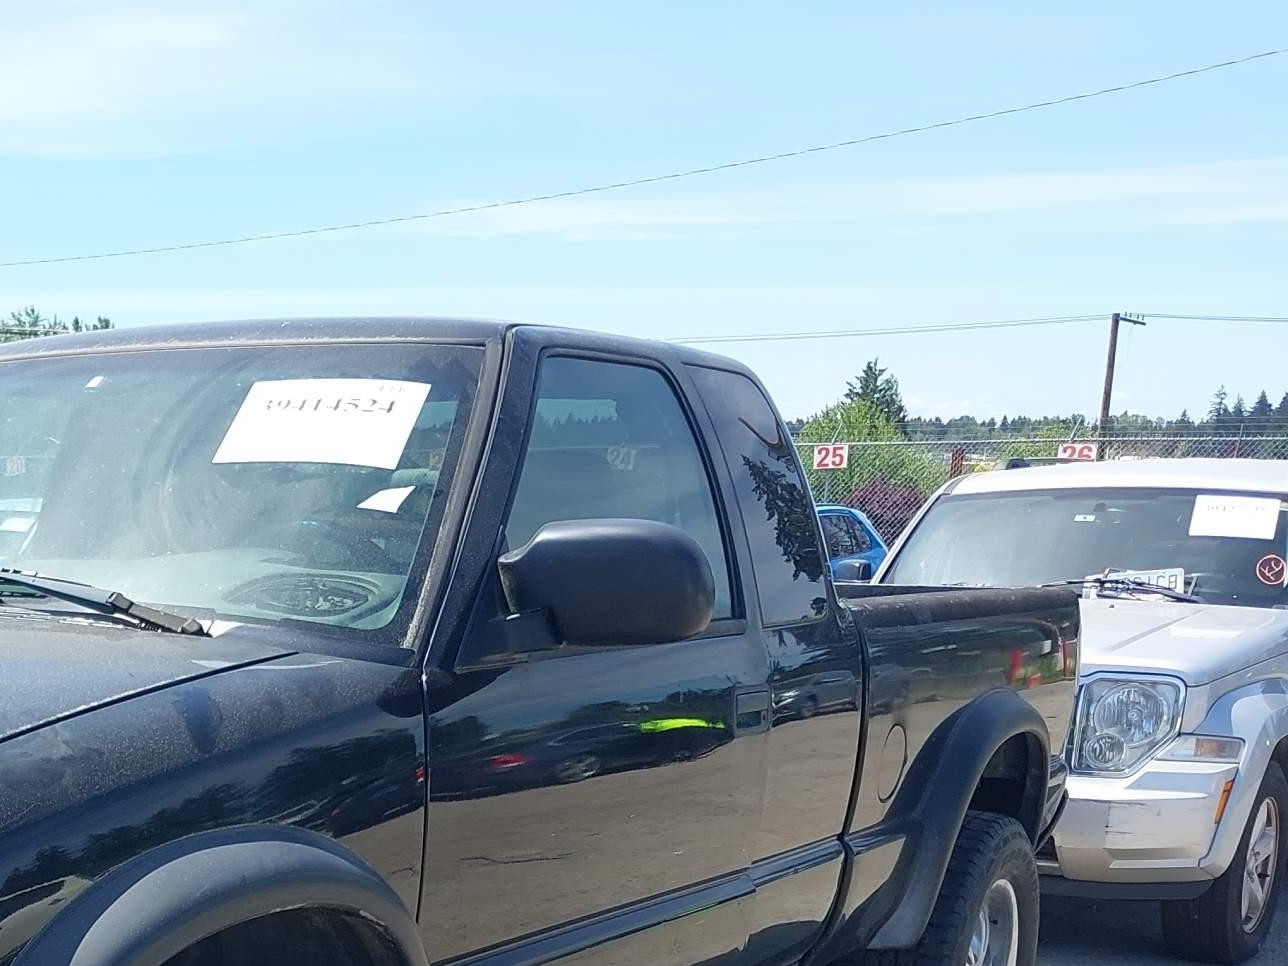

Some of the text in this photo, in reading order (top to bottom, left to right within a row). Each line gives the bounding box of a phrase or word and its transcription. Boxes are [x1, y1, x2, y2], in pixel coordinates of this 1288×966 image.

[265, 397, 397, 414] 39414524
[815, 446, 845, 468] 25
[1062, 445, 1094, 460] 26
